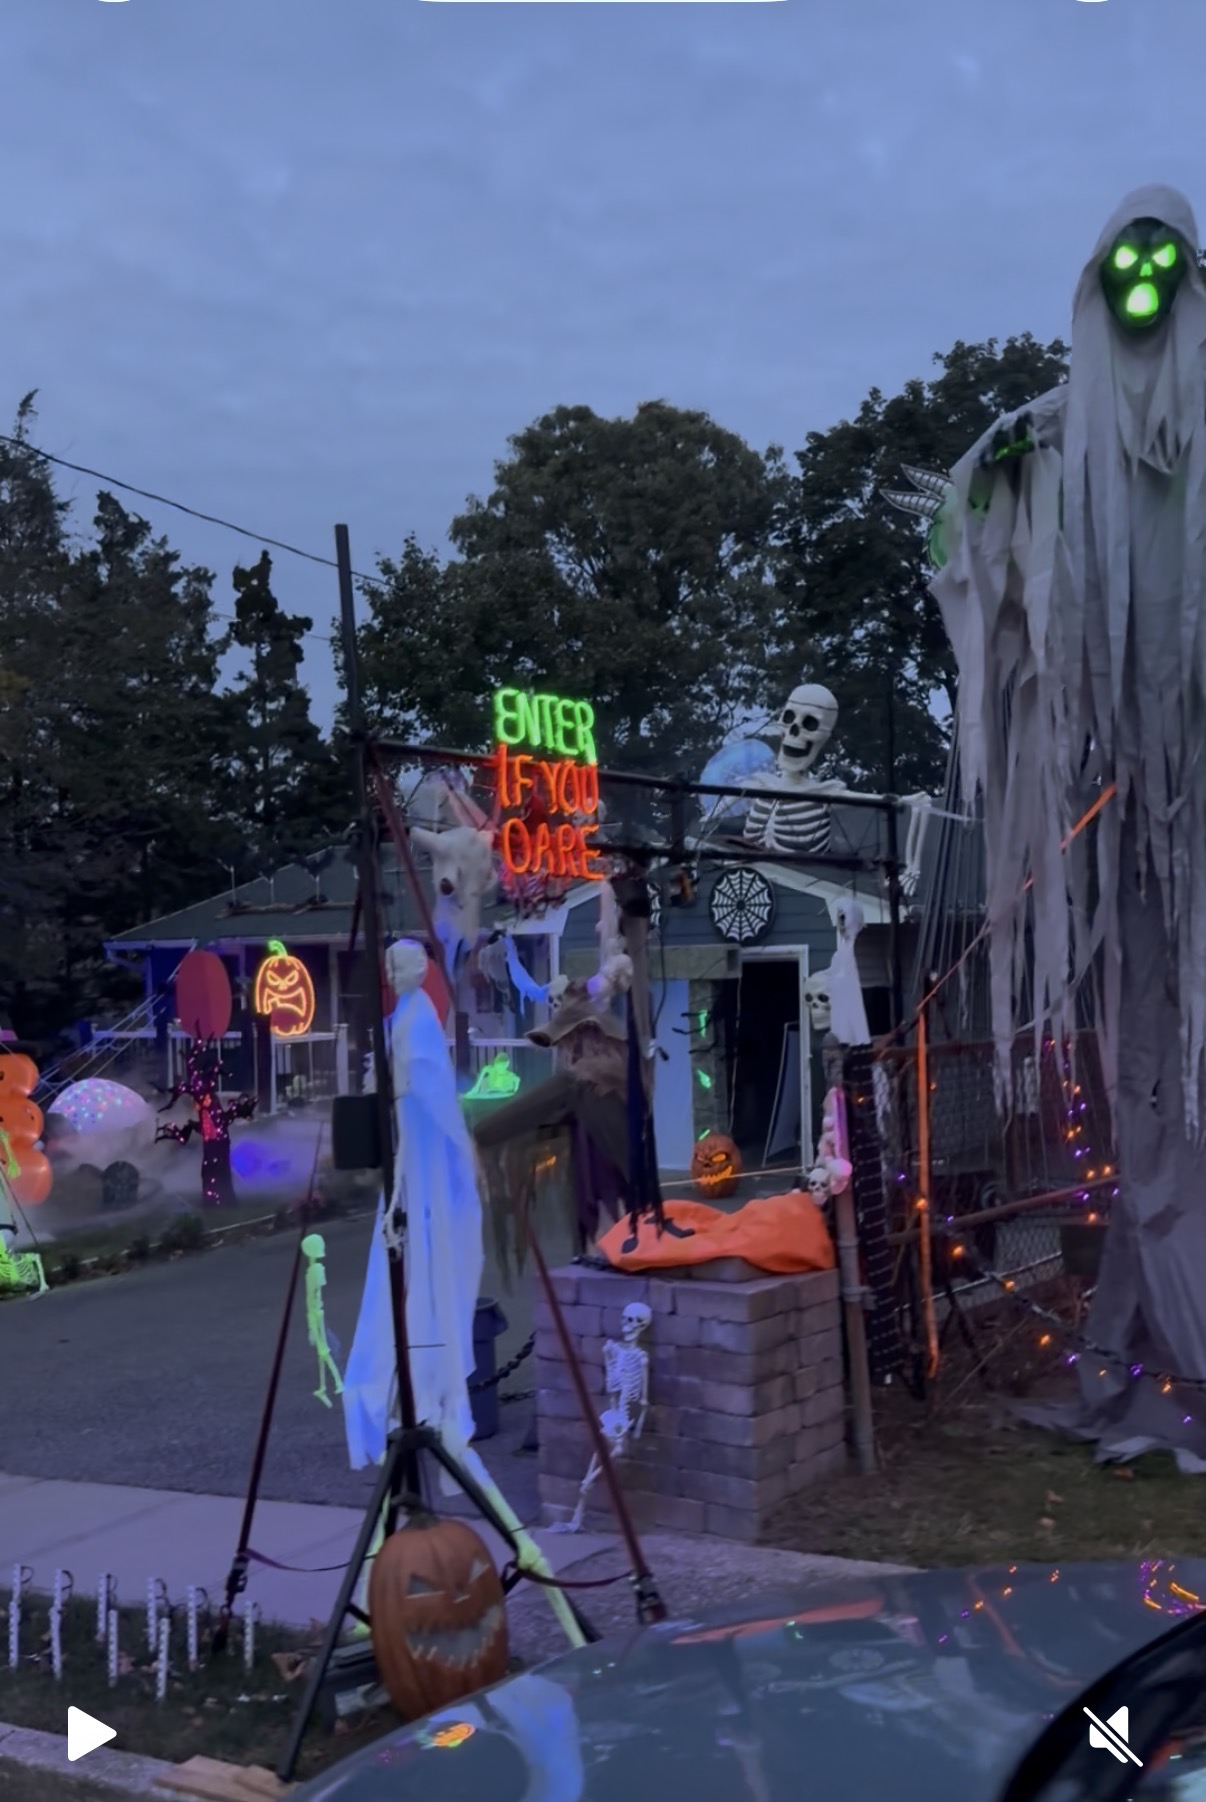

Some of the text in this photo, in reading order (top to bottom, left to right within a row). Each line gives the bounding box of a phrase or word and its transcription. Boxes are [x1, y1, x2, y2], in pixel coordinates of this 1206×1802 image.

[495, 688, 597, 765] ENTER
[497, 744, 599, 814] IF YOU
